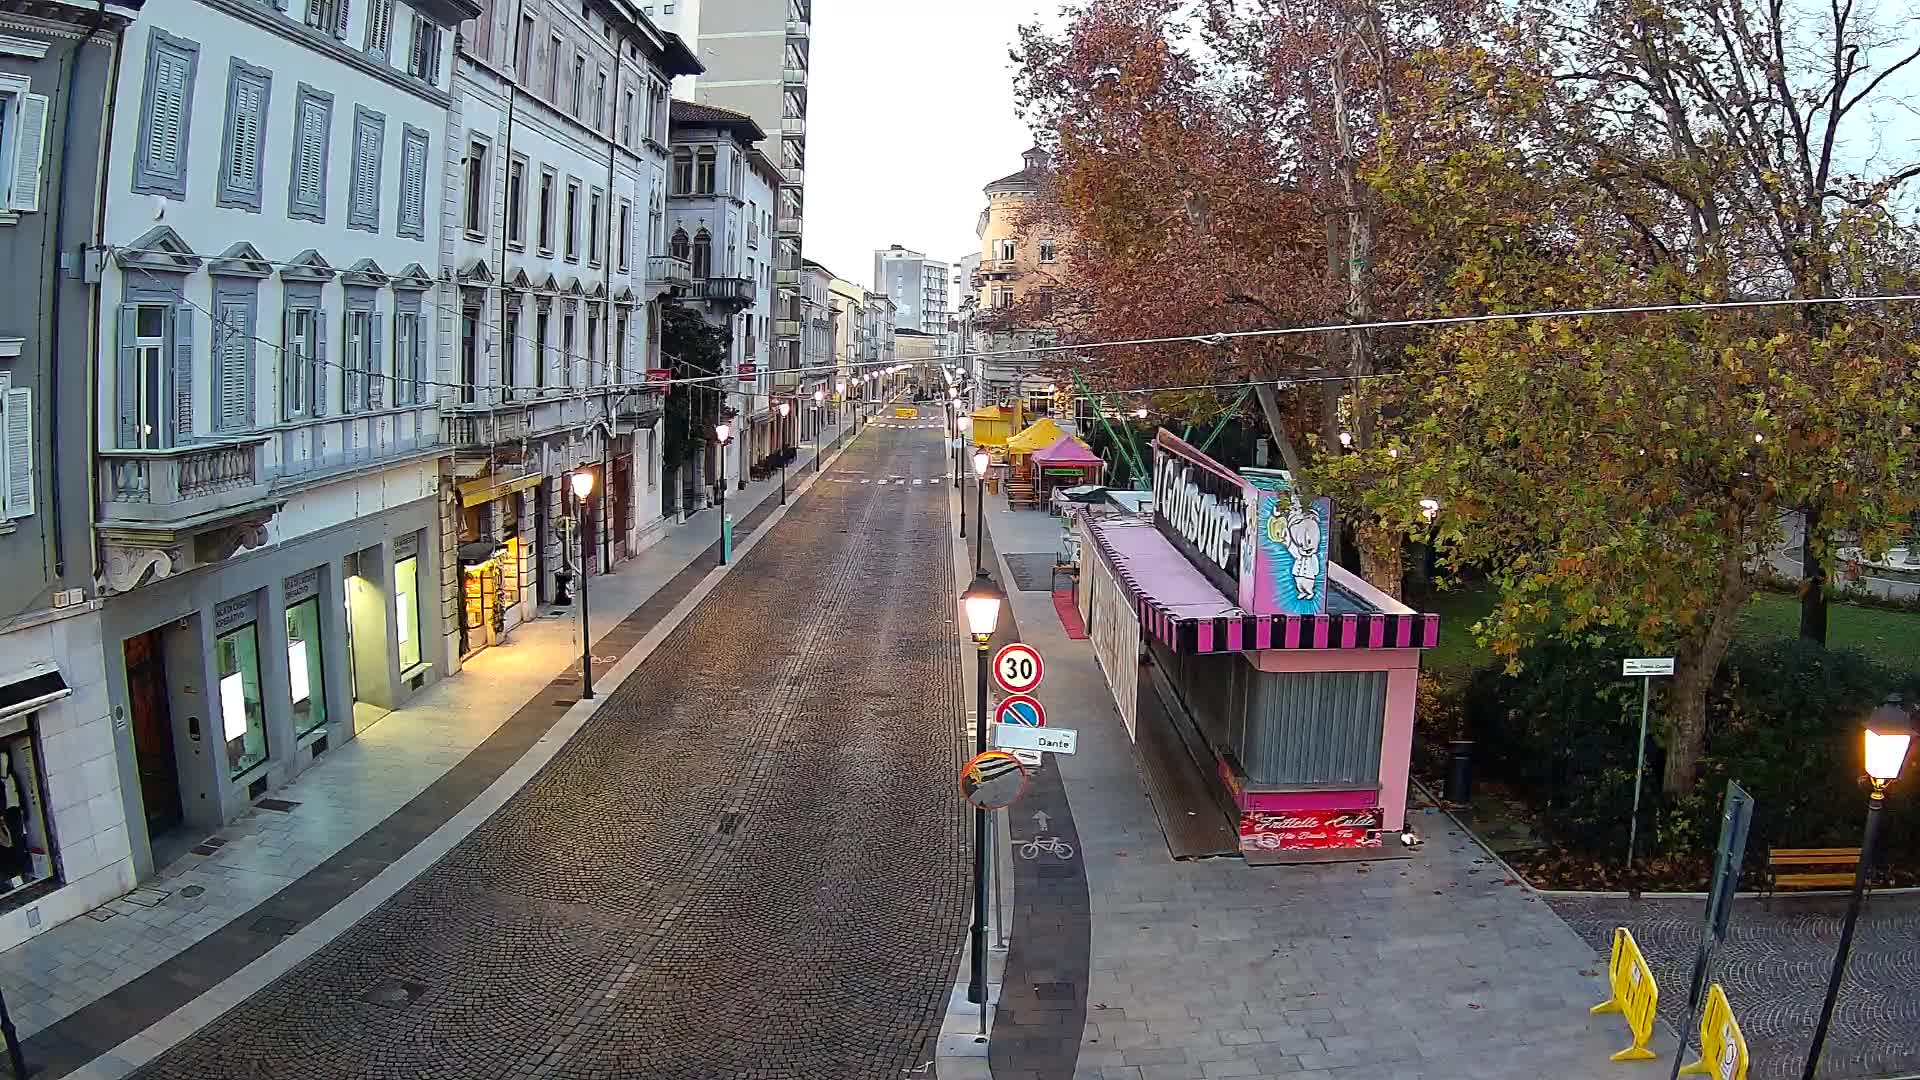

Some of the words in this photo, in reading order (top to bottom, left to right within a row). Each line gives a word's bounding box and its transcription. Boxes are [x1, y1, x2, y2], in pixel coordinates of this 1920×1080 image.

[1162, 458, 1233, 570] Golosone
[1006, 658, 1032, 679] 30
[1038, 737, 1070, 749] Dante
[1323, 813, 1377, 828] Calde
